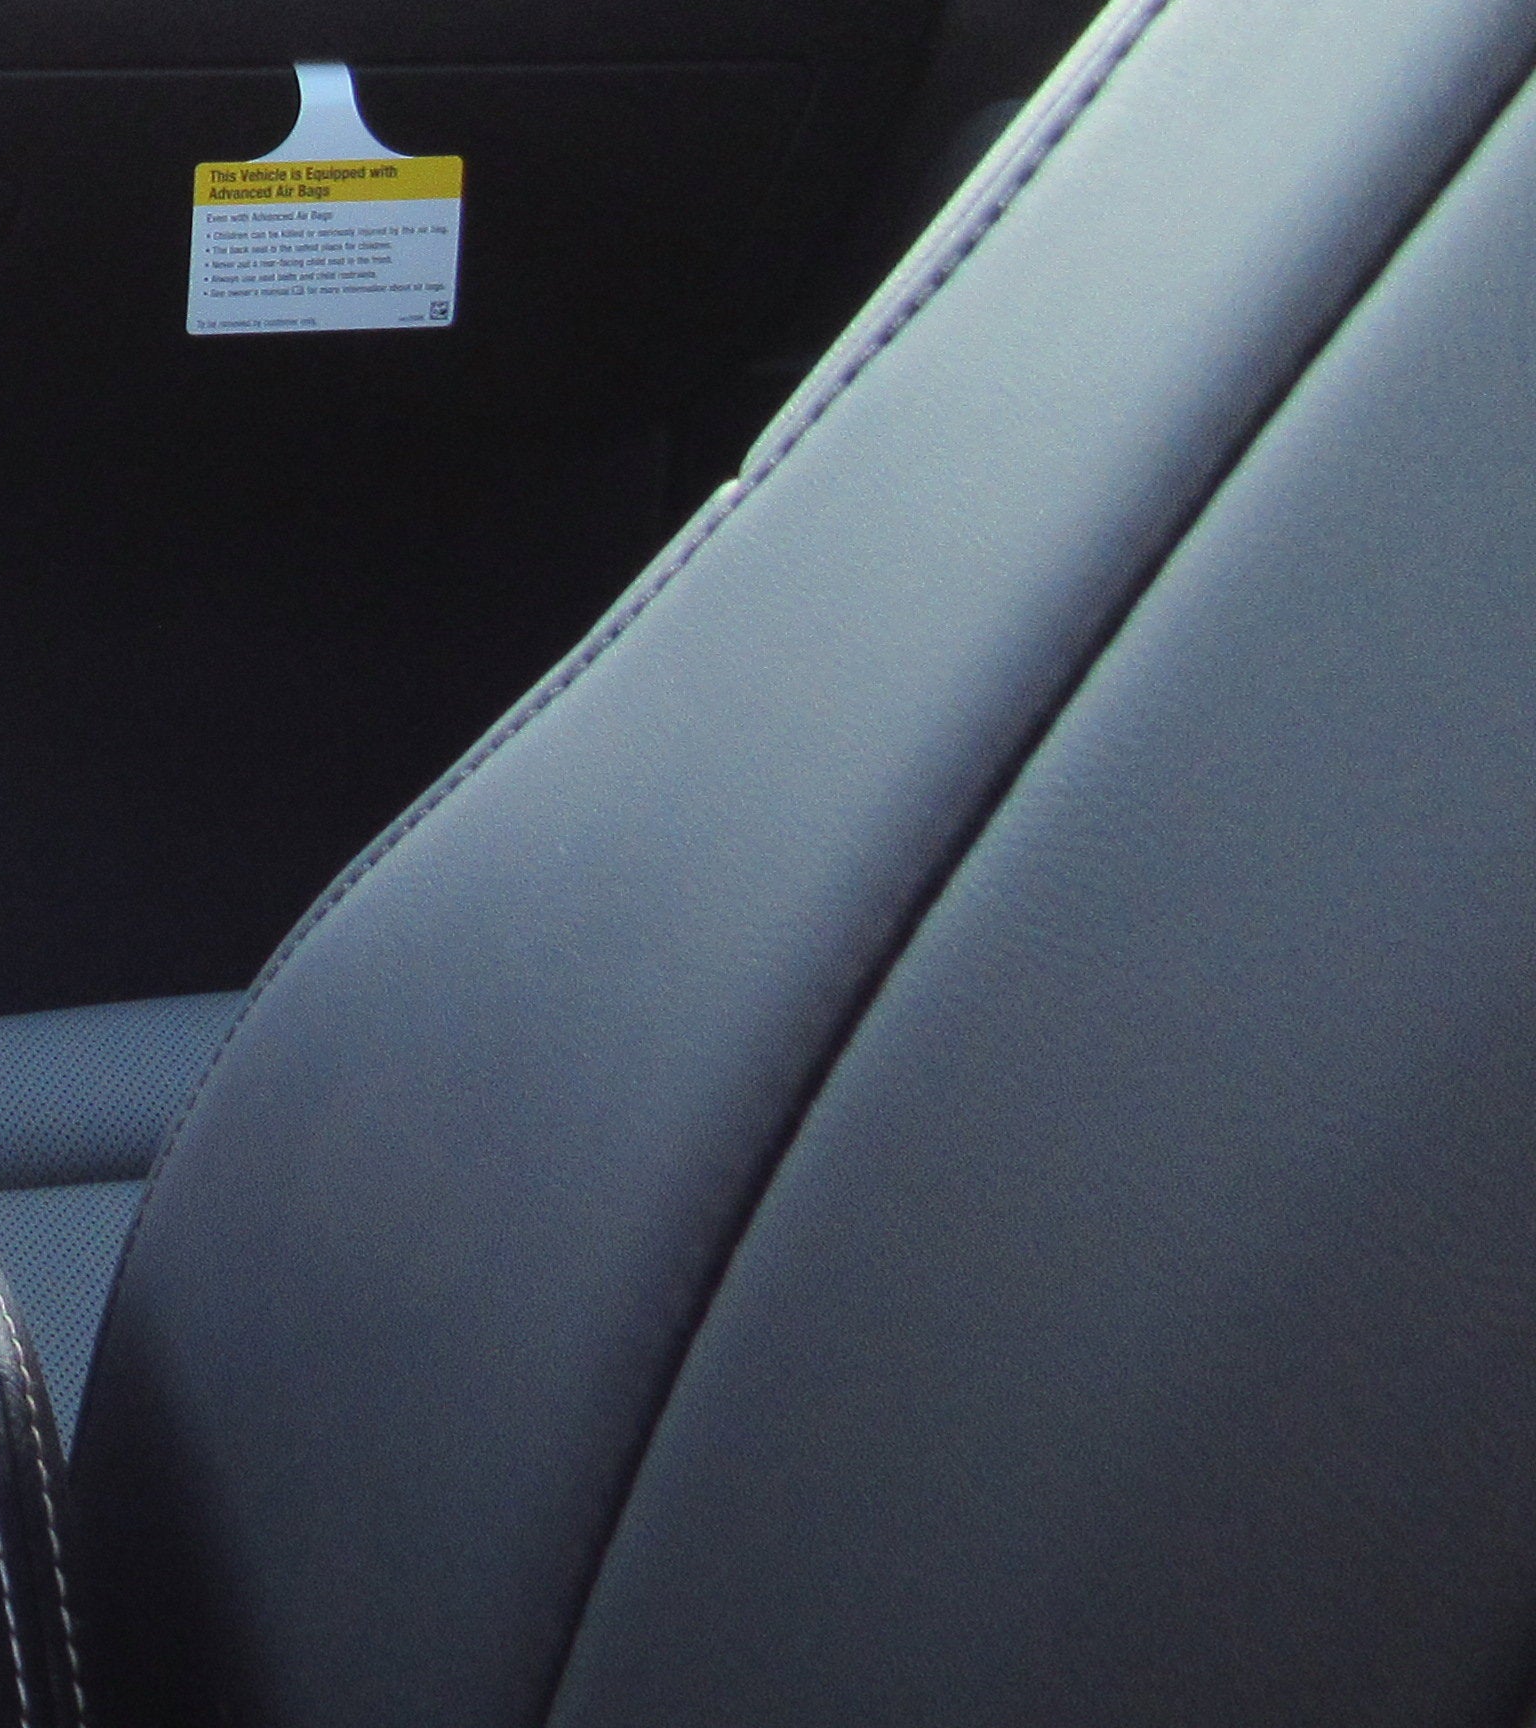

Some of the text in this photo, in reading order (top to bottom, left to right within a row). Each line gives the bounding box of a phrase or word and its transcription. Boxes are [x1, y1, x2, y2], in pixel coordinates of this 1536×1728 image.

[211, 165, 398, 183] This Vehicle is Equipped with
[209, 184, 330, 200] Advanced Air Bags
